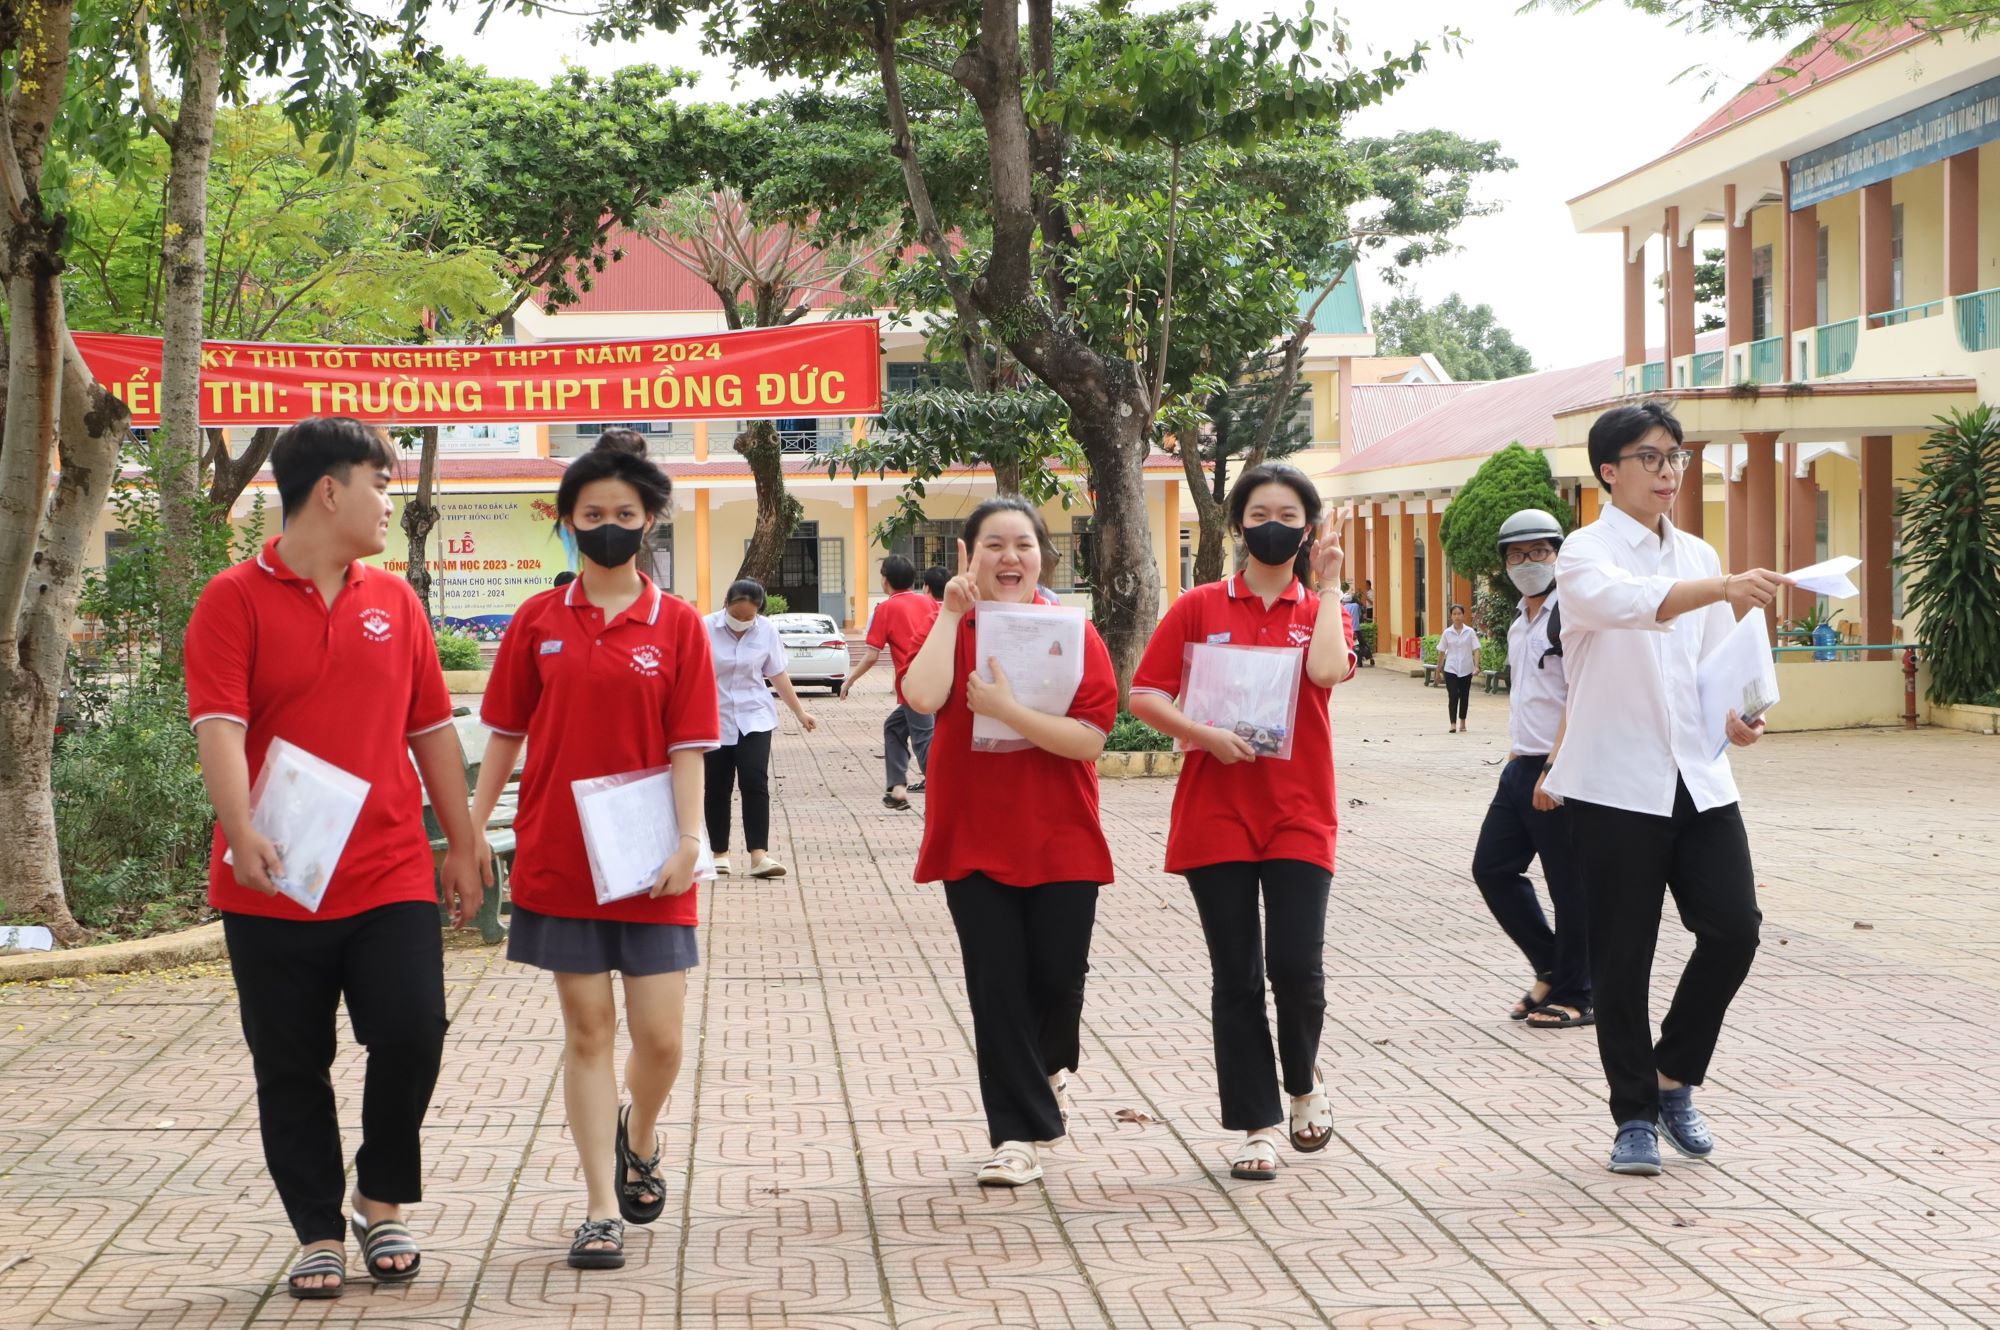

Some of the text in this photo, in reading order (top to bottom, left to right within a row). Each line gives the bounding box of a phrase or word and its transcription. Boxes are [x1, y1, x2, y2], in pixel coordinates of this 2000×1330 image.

[200, 342, 722, 371] KỲ THI TỐT NGHIỆP THPT NĂM 2024
[99, 364, 846, 415] IỂ THI: TRƯỜNG THPT HỒNG ĐỨC
[448, 531, 475, 554] LỄ
[460, 560, 480, 573] HỌC
[483, 559, 507, 570] 2023
[517, 559, 541, 569] 2024
[470, 578, 485, 586] CHO
[504, 577, 522, 585] SINH
[545, 577, 553, 585] 12
[462, 590, 480, 598] 2021
[487, 590, 505, 598] 2024
[359, 608, 391, 619] VICTORY
[363, 631, 393, 642] SCHOOL
[631, 645, 662, 658] VICTORY
